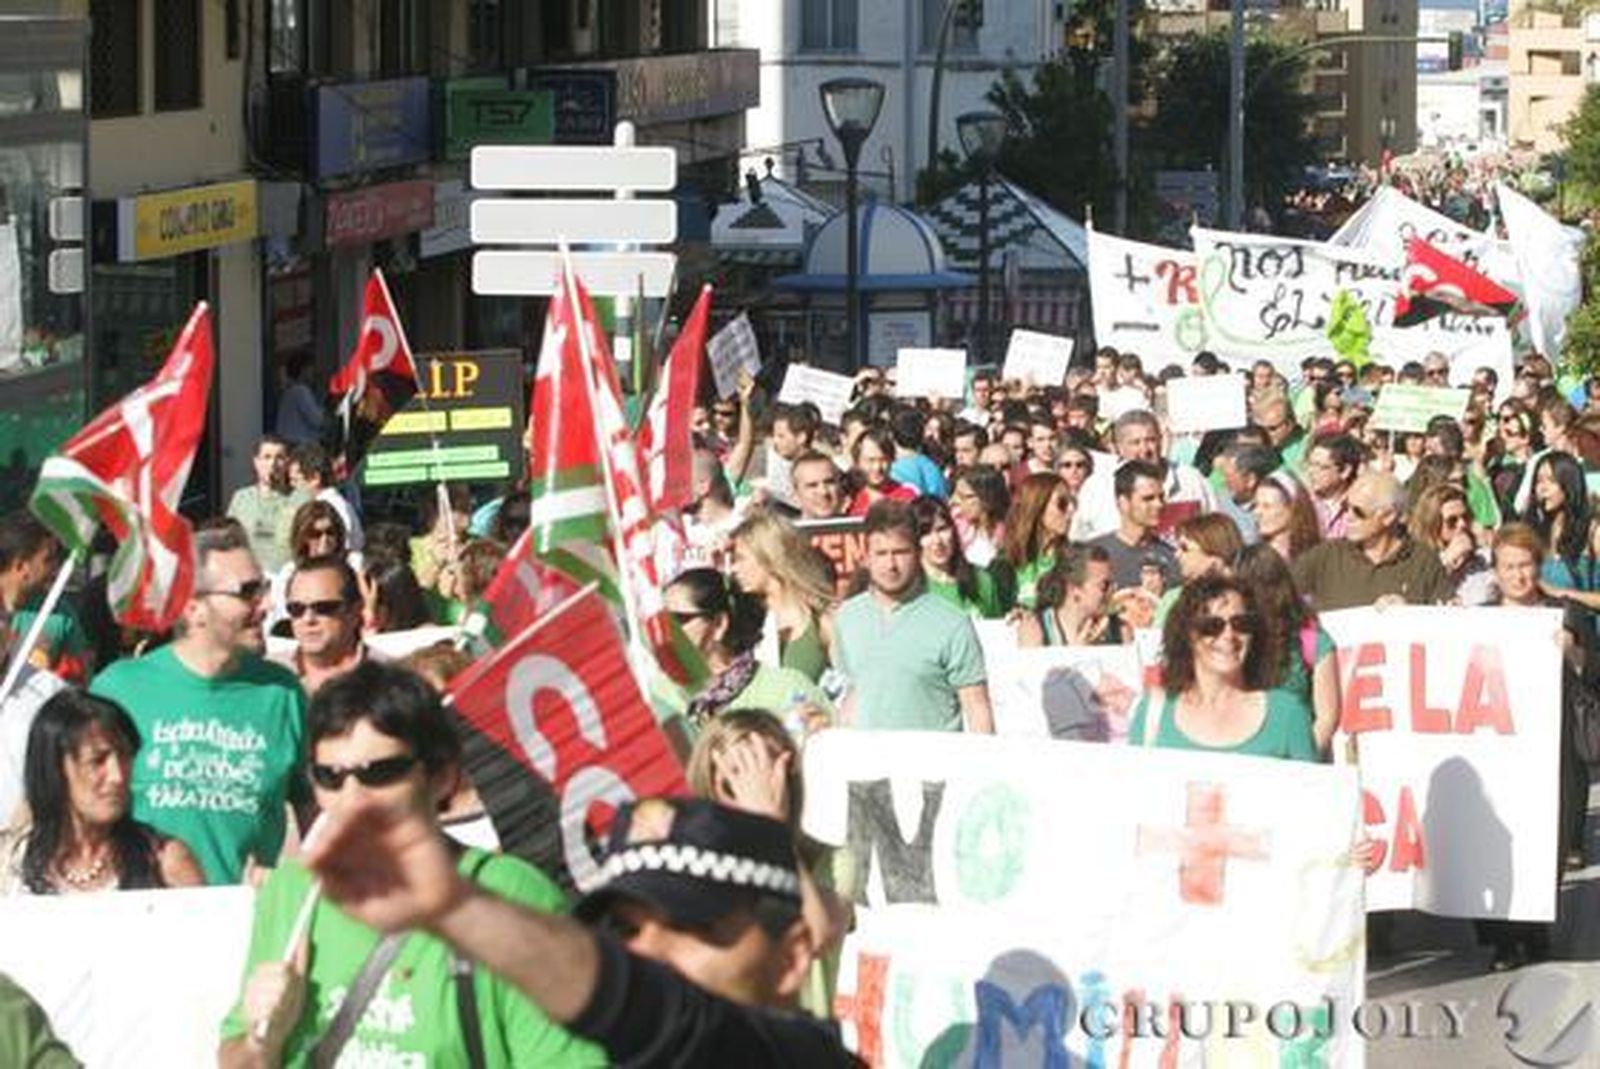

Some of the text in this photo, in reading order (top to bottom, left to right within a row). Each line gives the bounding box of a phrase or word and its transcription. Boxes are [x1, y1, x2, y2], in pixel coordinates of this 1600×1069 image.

[414, 359, 480, 399] LP
[1410, 643, 1516, 734] LA
[846, 777, 1024, 907] NO
